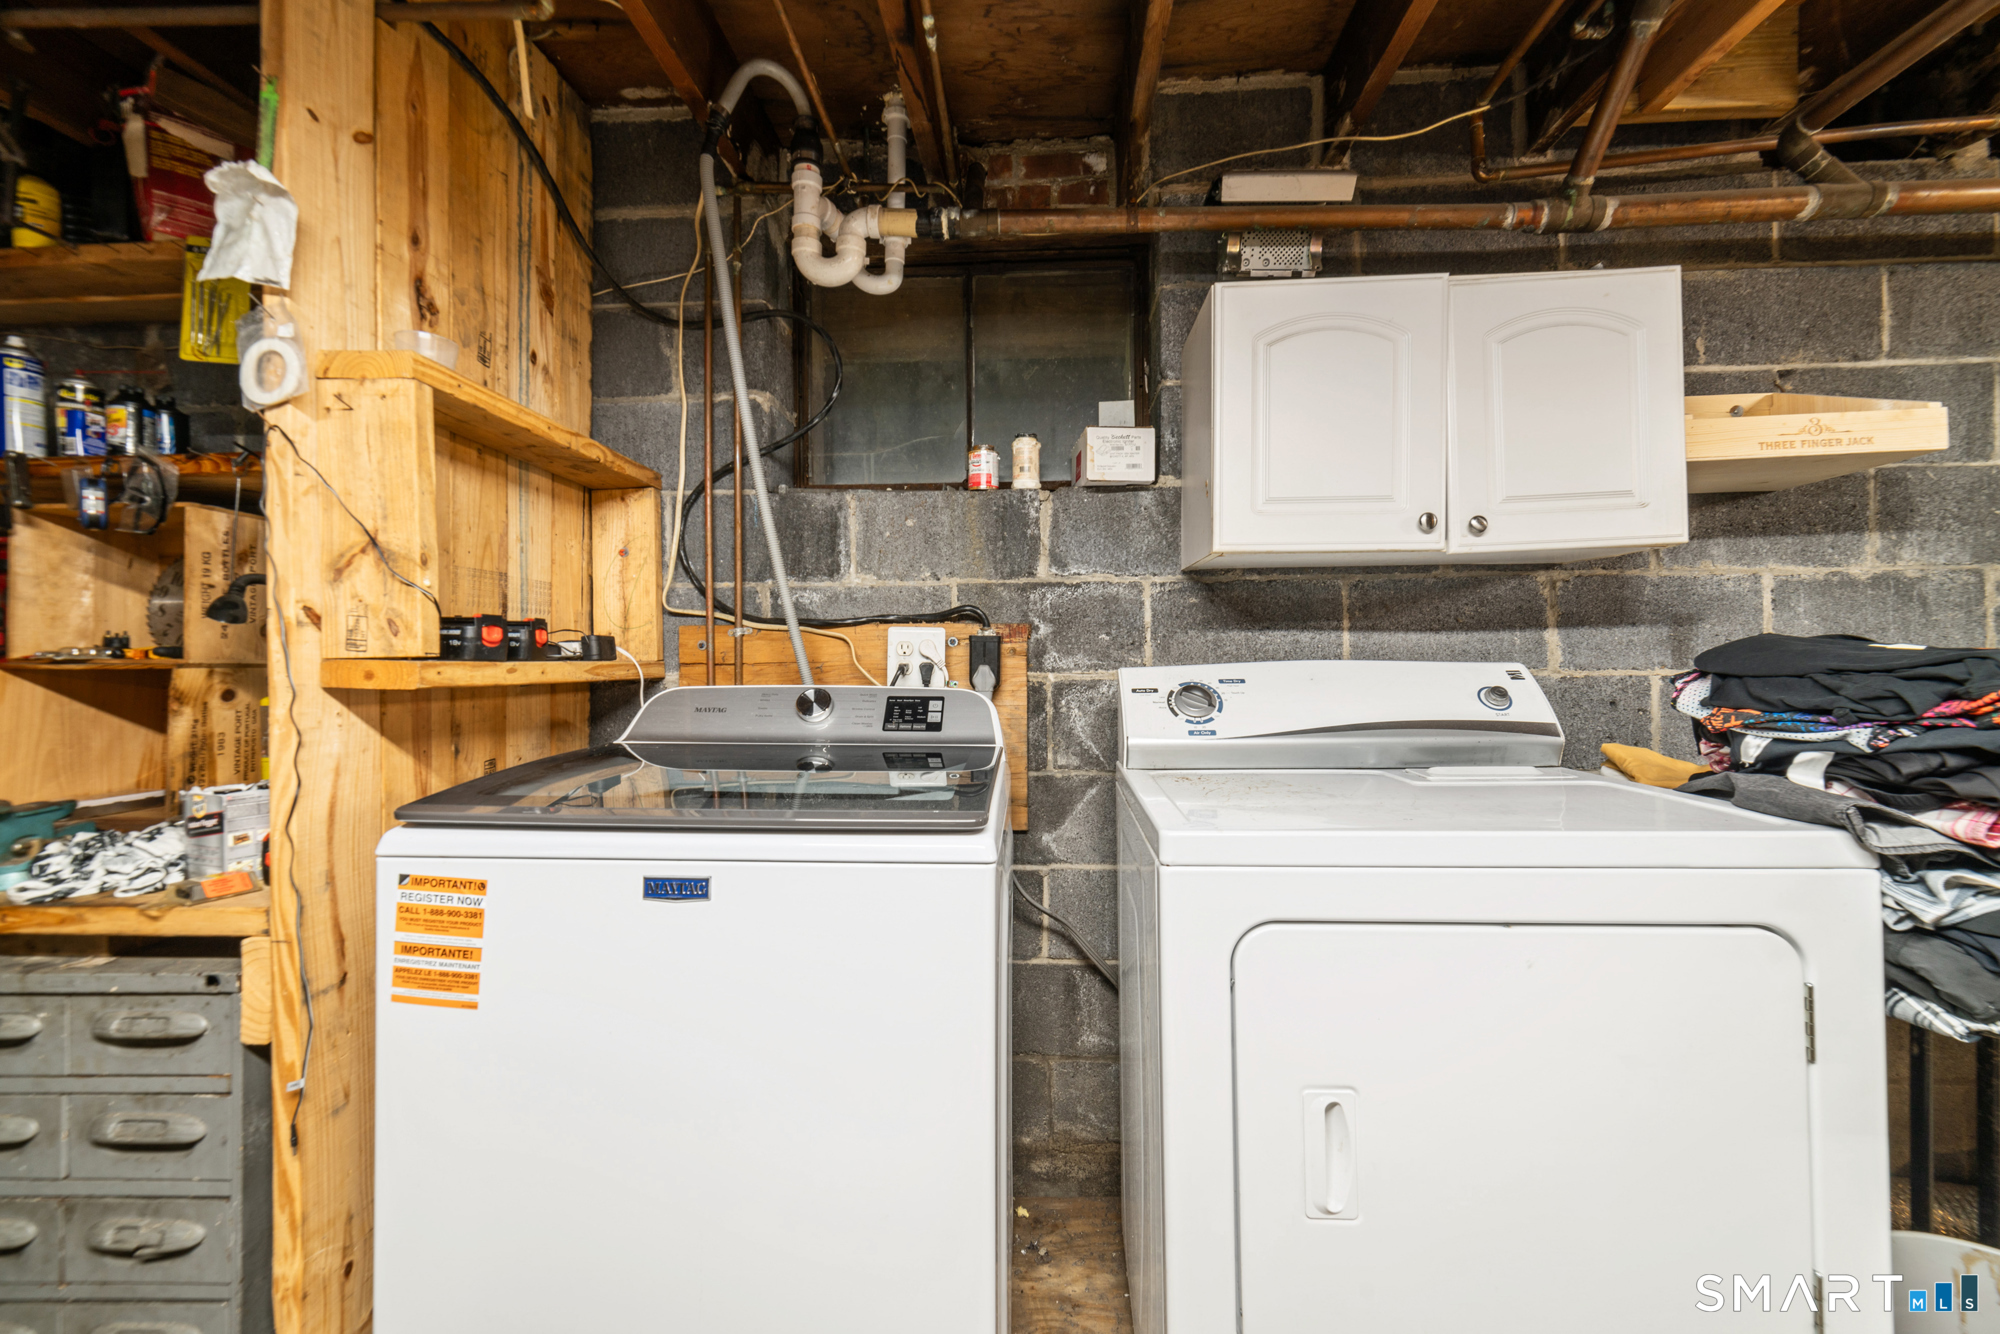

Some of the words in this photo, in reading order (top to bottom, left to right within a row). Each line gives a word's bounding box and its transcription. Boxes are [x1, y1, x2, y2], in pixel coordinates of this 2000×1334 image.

[1807, 417, 1823, 436] 3
[1758, 440, 1796, 451] THREE
[1801, 438, 1843, 449] FINGER
[1846, 436, 1875, 447] JACK
[201, 551, 212, 565] KG
[249, 544, 257, 573] PORT
[249, 584, 257, 624] VINTAG
[234, 709, 242, 734] PORT
[216, 732, 226, 756] 1983
[243, 739, 249, 748] OF
[233, 736, 242, 775] VINTAGE
[411, 877, 477, 890] IMPORTANT!
[647, 881, 706, 895] MAYTAG
[400, 892, 454, 904] REGISTER
[457, 896, 483, 907] NOW
[398, 906, 420, 915] CALL
[423, 908, 482, 919] 1-888-900-3381
[401, 945, 473, 959] IMPORTANTE!
[394, 957, 437, 966] ENREGISTREZ
[438, 961, 480, 970] MAINTENANT
[394, 967, 422, 976] APPELEZ
